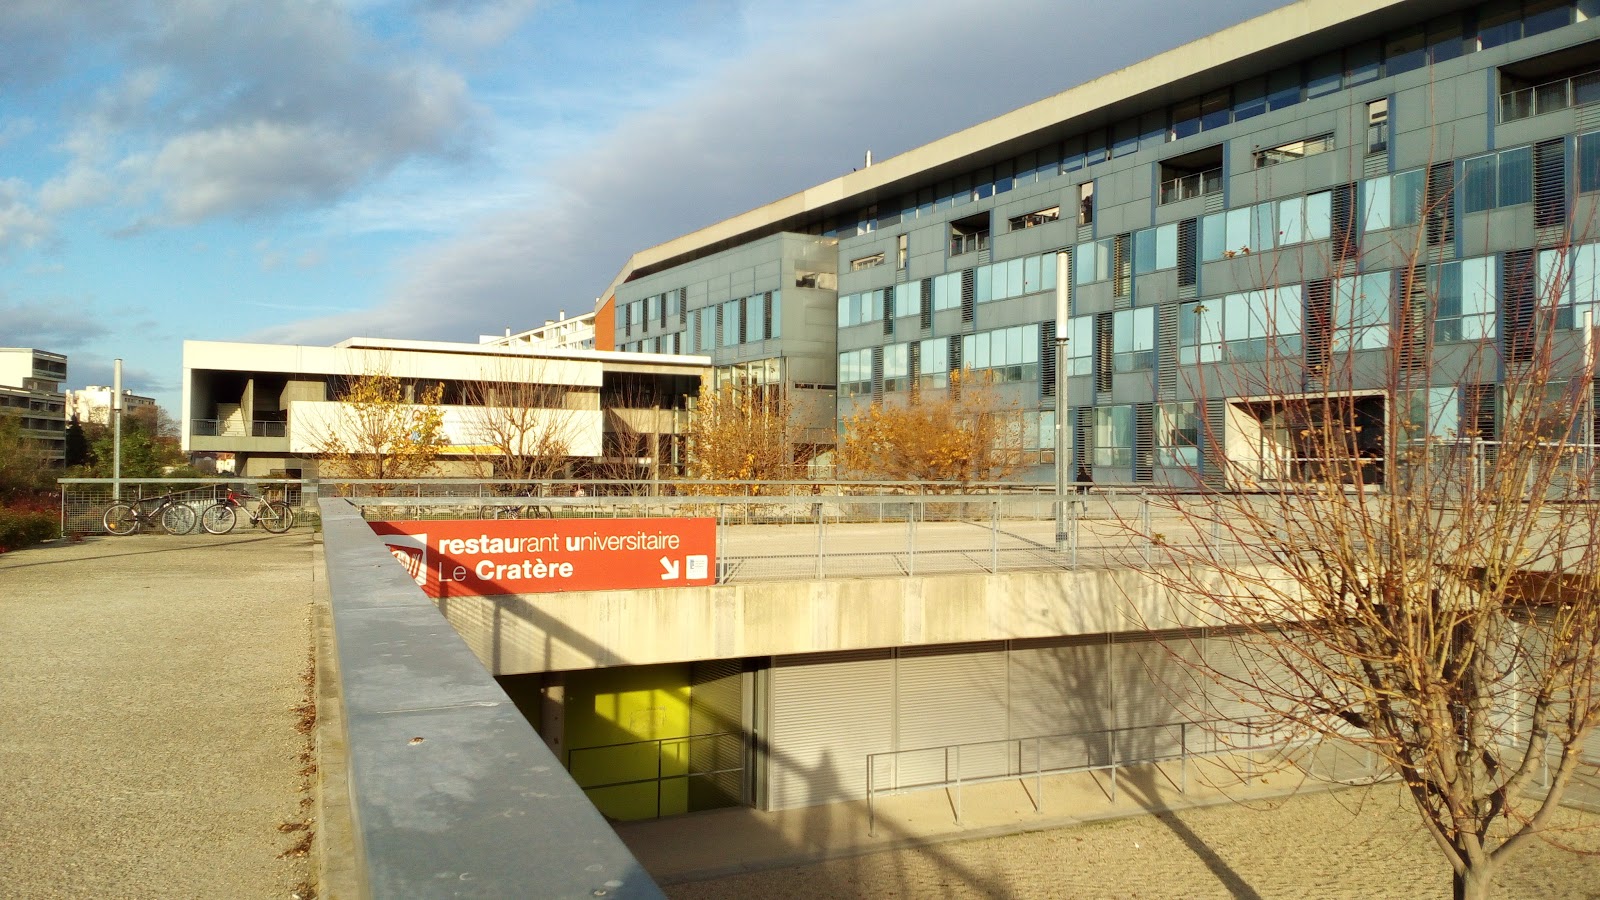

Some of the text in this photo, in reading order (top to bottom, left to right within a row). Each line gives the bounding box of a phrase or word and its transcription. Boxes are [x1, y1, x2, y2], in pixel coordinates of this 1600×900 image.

[438, 530, 680, 554] restaurant universitaire
[438, 558, 574, 582] Le Cratère
